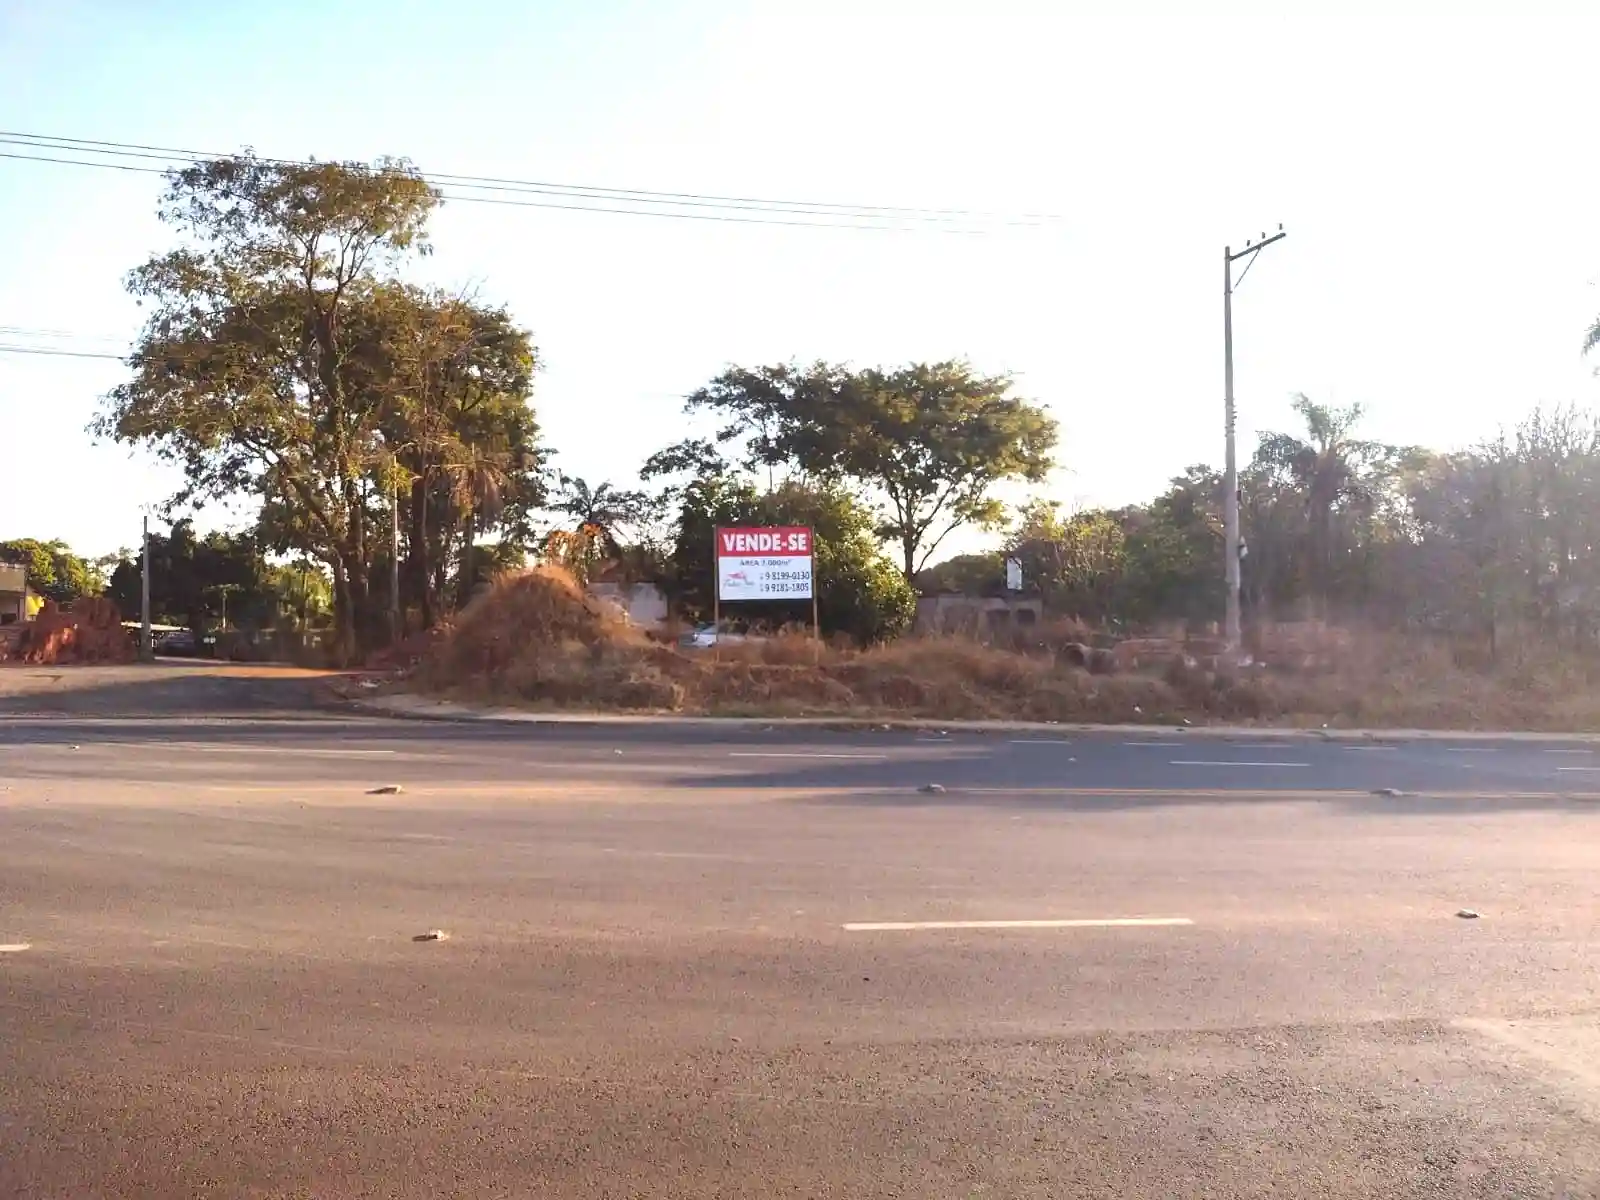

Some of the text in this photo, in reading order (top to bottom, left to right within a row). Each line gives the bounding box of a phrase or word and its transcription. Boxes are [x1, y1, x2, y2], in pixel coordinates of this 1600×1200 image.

[723, 533, 807, 552] VENDE-SE
[765, 571, 770, 580] 9
[765, 583, 770, 592] 9
